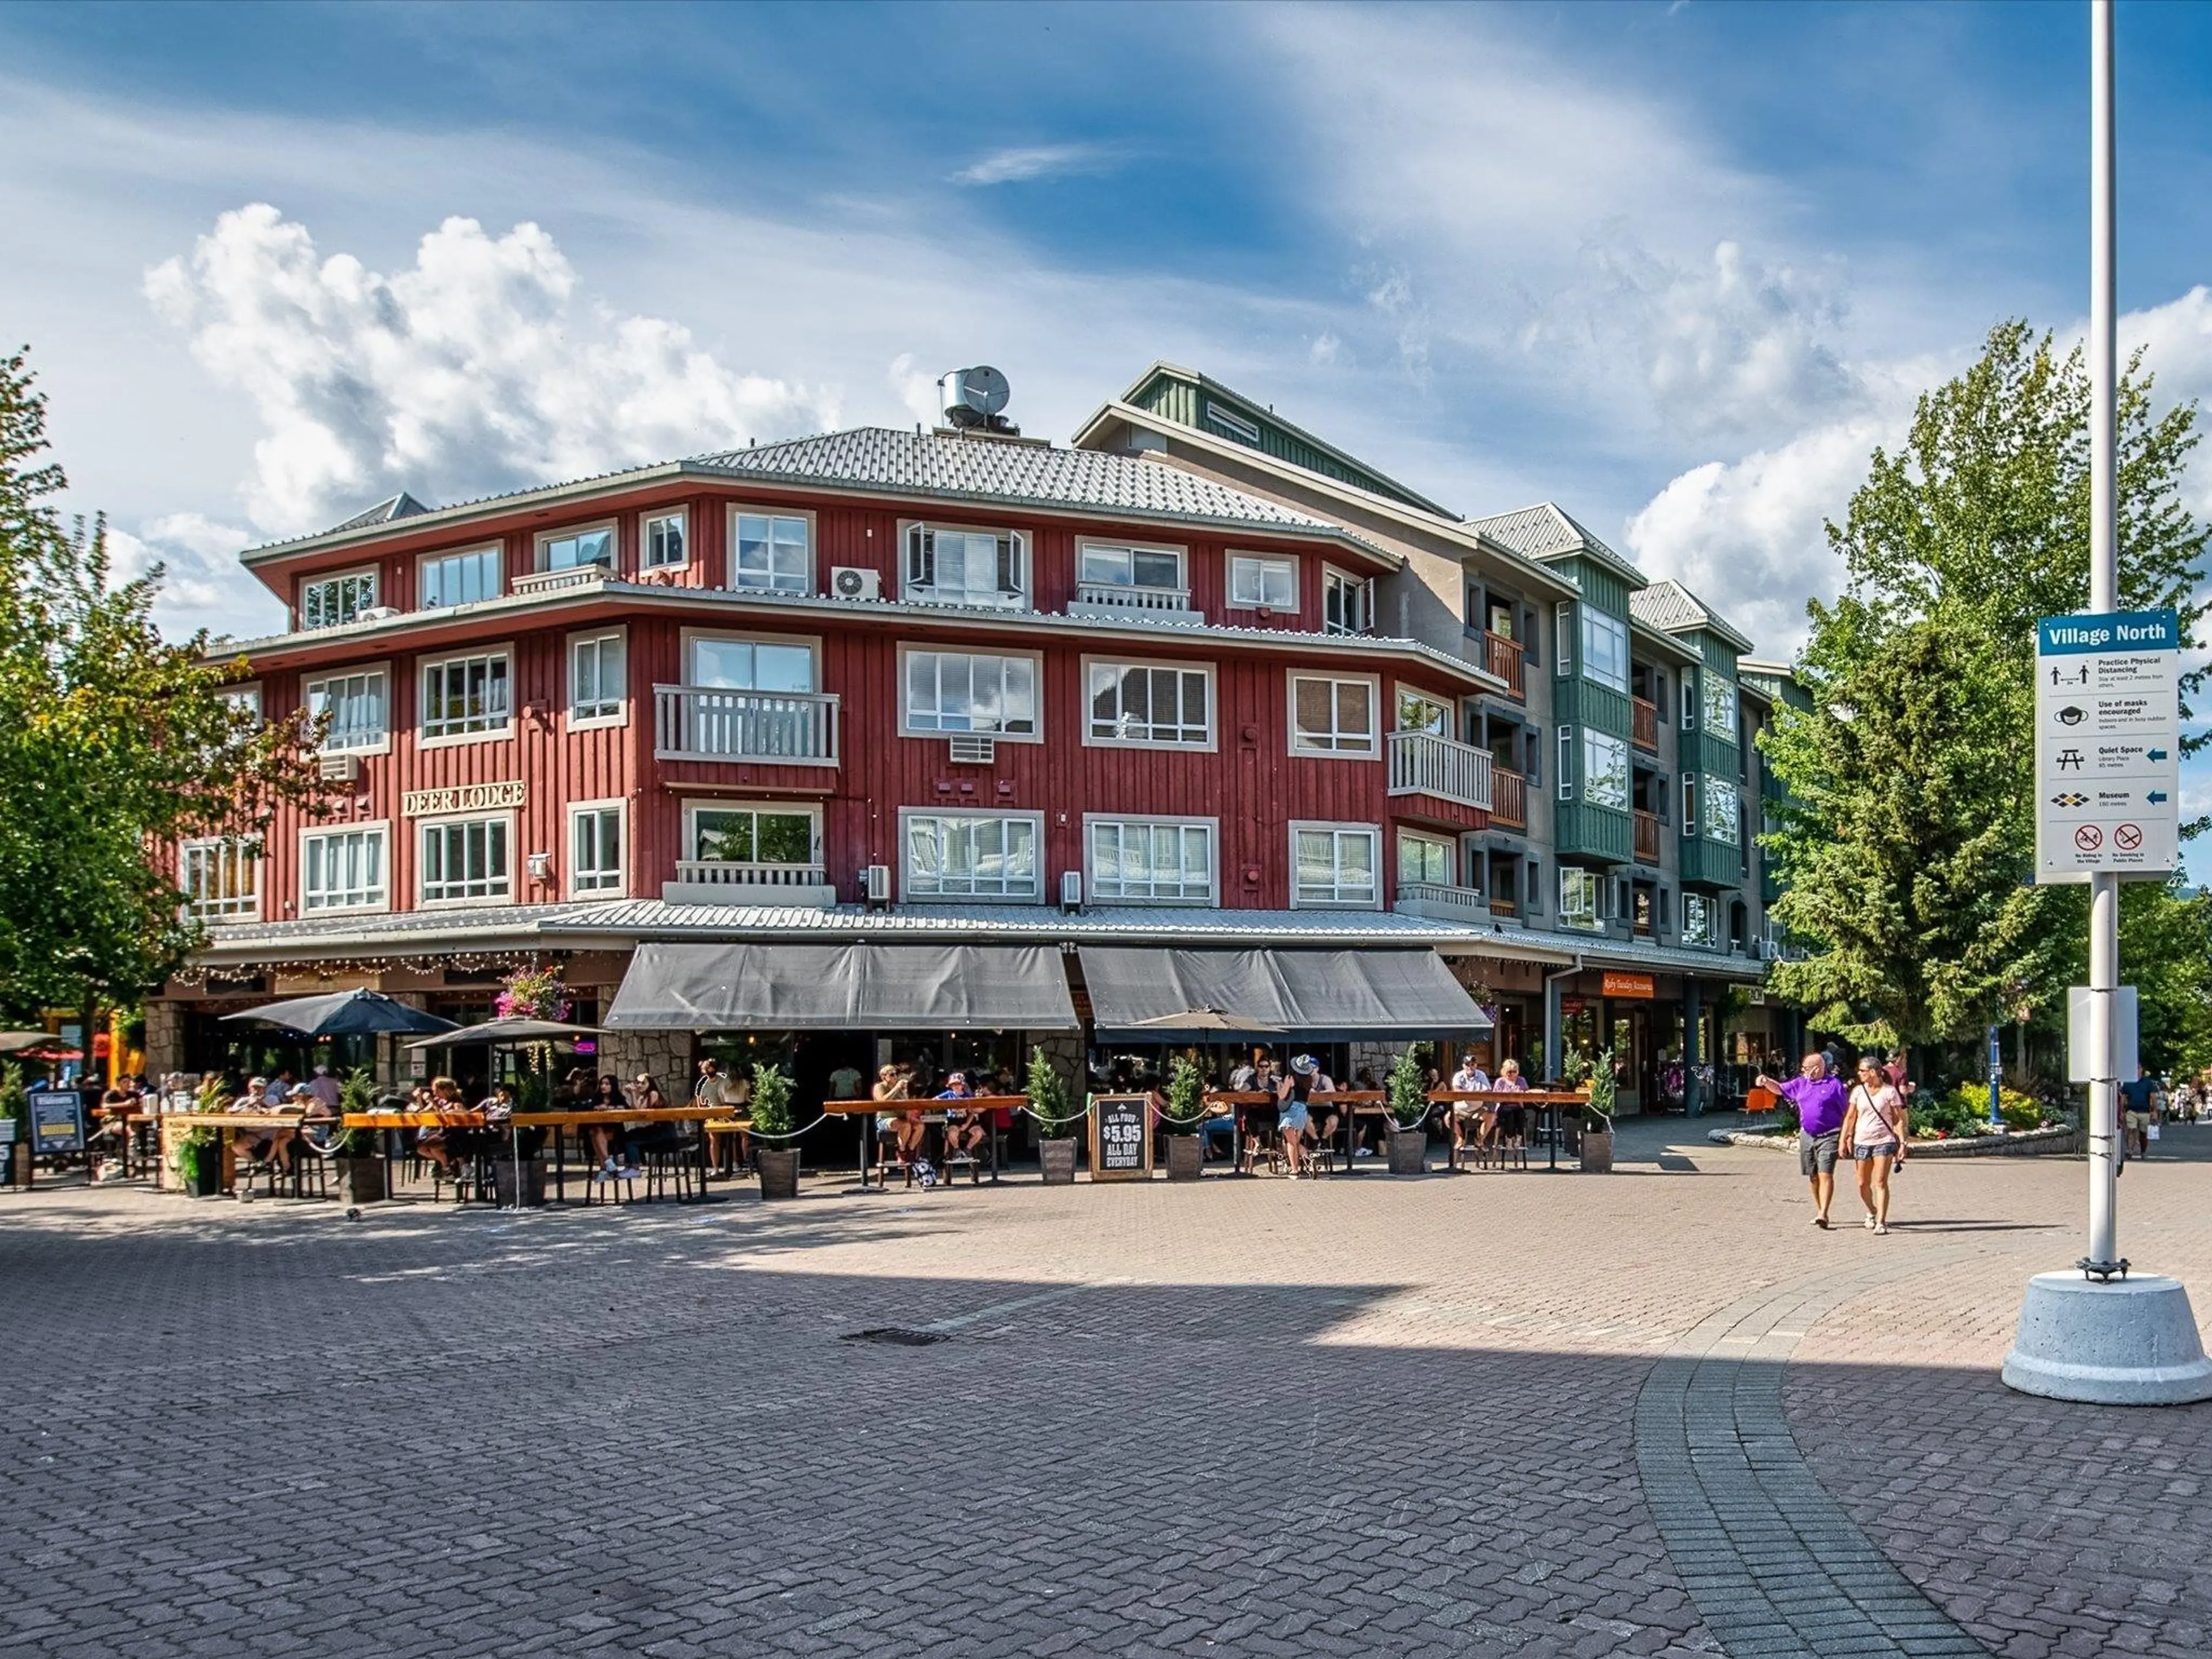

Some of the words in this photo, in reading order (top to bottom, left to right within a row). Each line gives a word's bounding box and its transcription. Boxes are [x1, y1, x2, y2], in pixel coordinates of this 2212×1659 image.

[2049, 628, 2110, 646] Village
[2116, 623, 2166, 641] North
[2130, 657, 2161, 665] Physical
[2099, 707, 2141, 716] encouraged
[2120, 746, 2143, 754] Space
[403, 791, 457, 813] DEER
[459, 783, 526, 808] LODGE
[1108, 1113, 1120, 1124] ALL
[1120, 1112, 1137, 1123] FOOD
[1103, 1124, 1141, 1142] $5.95
[1107, 1143, 1122, 1156] ALL
[1123, 1143, 1138, 1156] DAY
[1107, 1156, 1138, 1168] EVERYDAY
